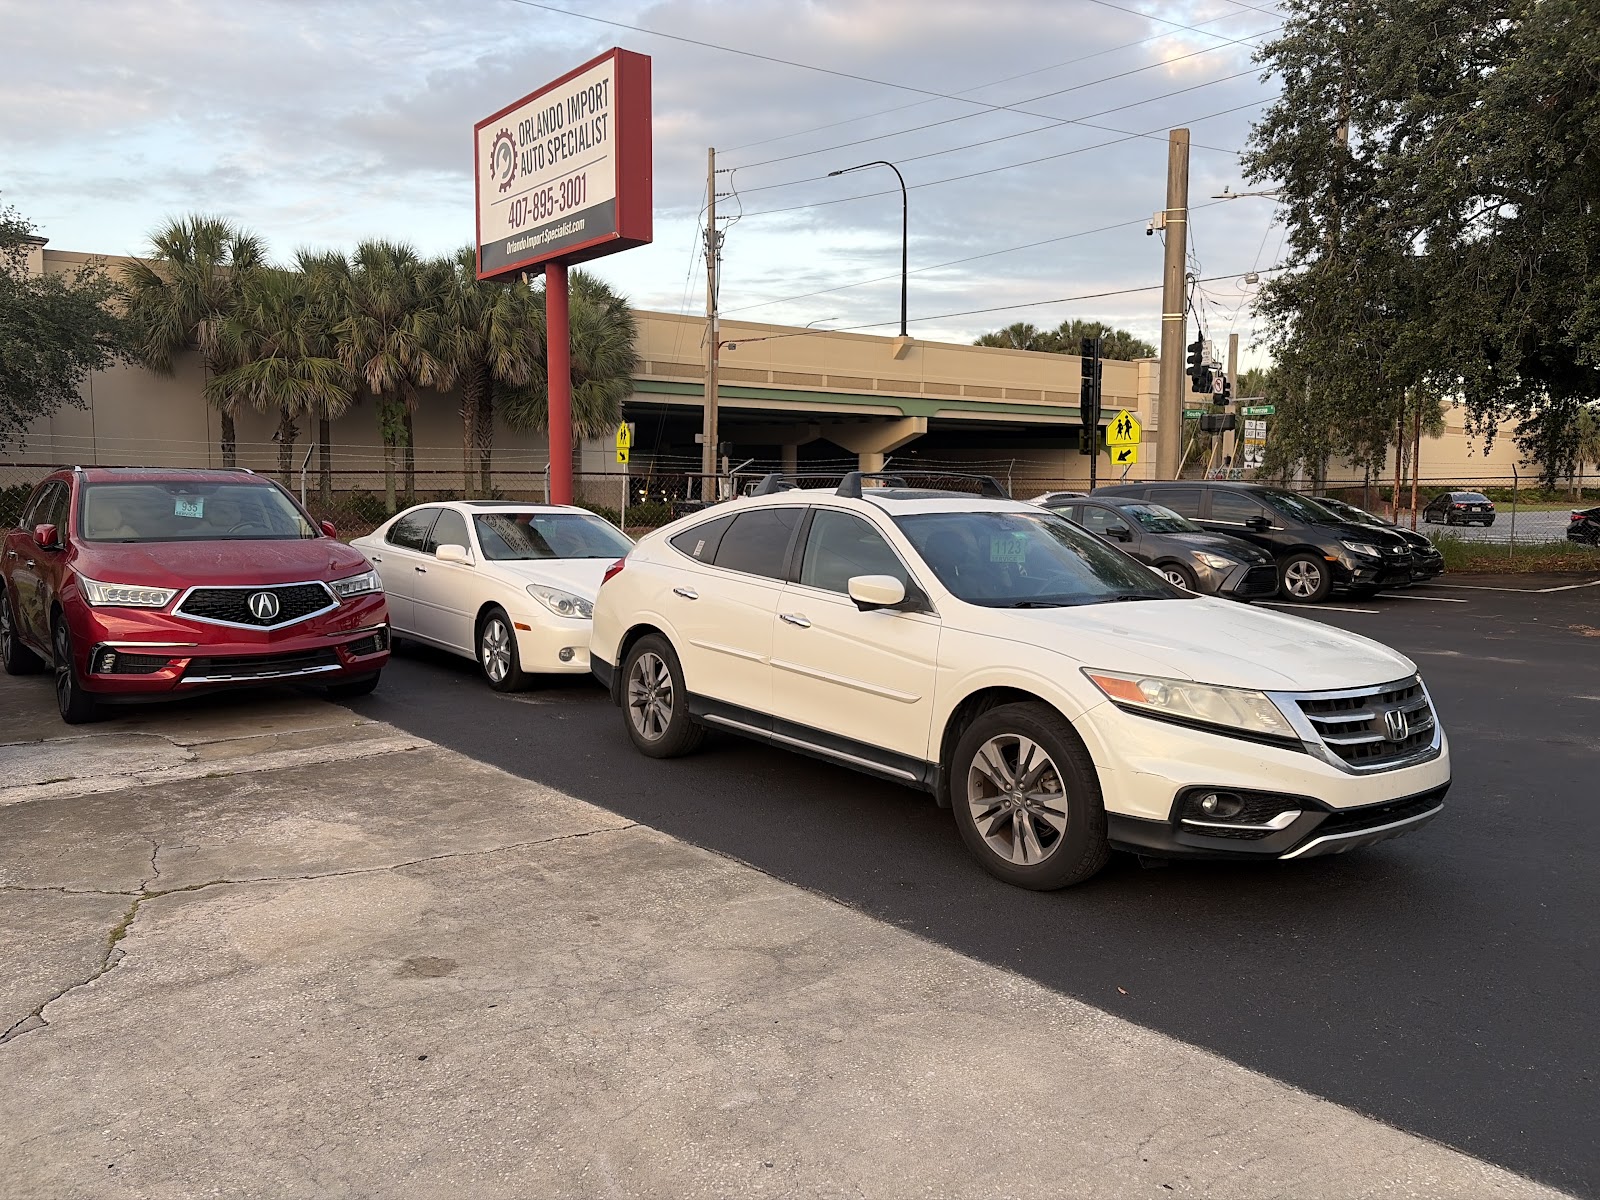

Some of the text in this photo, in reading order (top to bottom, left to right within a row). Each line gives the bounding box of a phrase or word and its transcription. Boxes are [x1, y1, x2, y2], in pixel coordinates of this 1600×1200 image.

[518, 77, 609, 148] ORLANDO IMPORT
[520, 112, 608, 178] AUTO SPECIALIST
[508, 172, 587, 230] 407-895-3001
[181, 501, 198, 513] 935
[994, 540, 1022, 555] 1123
